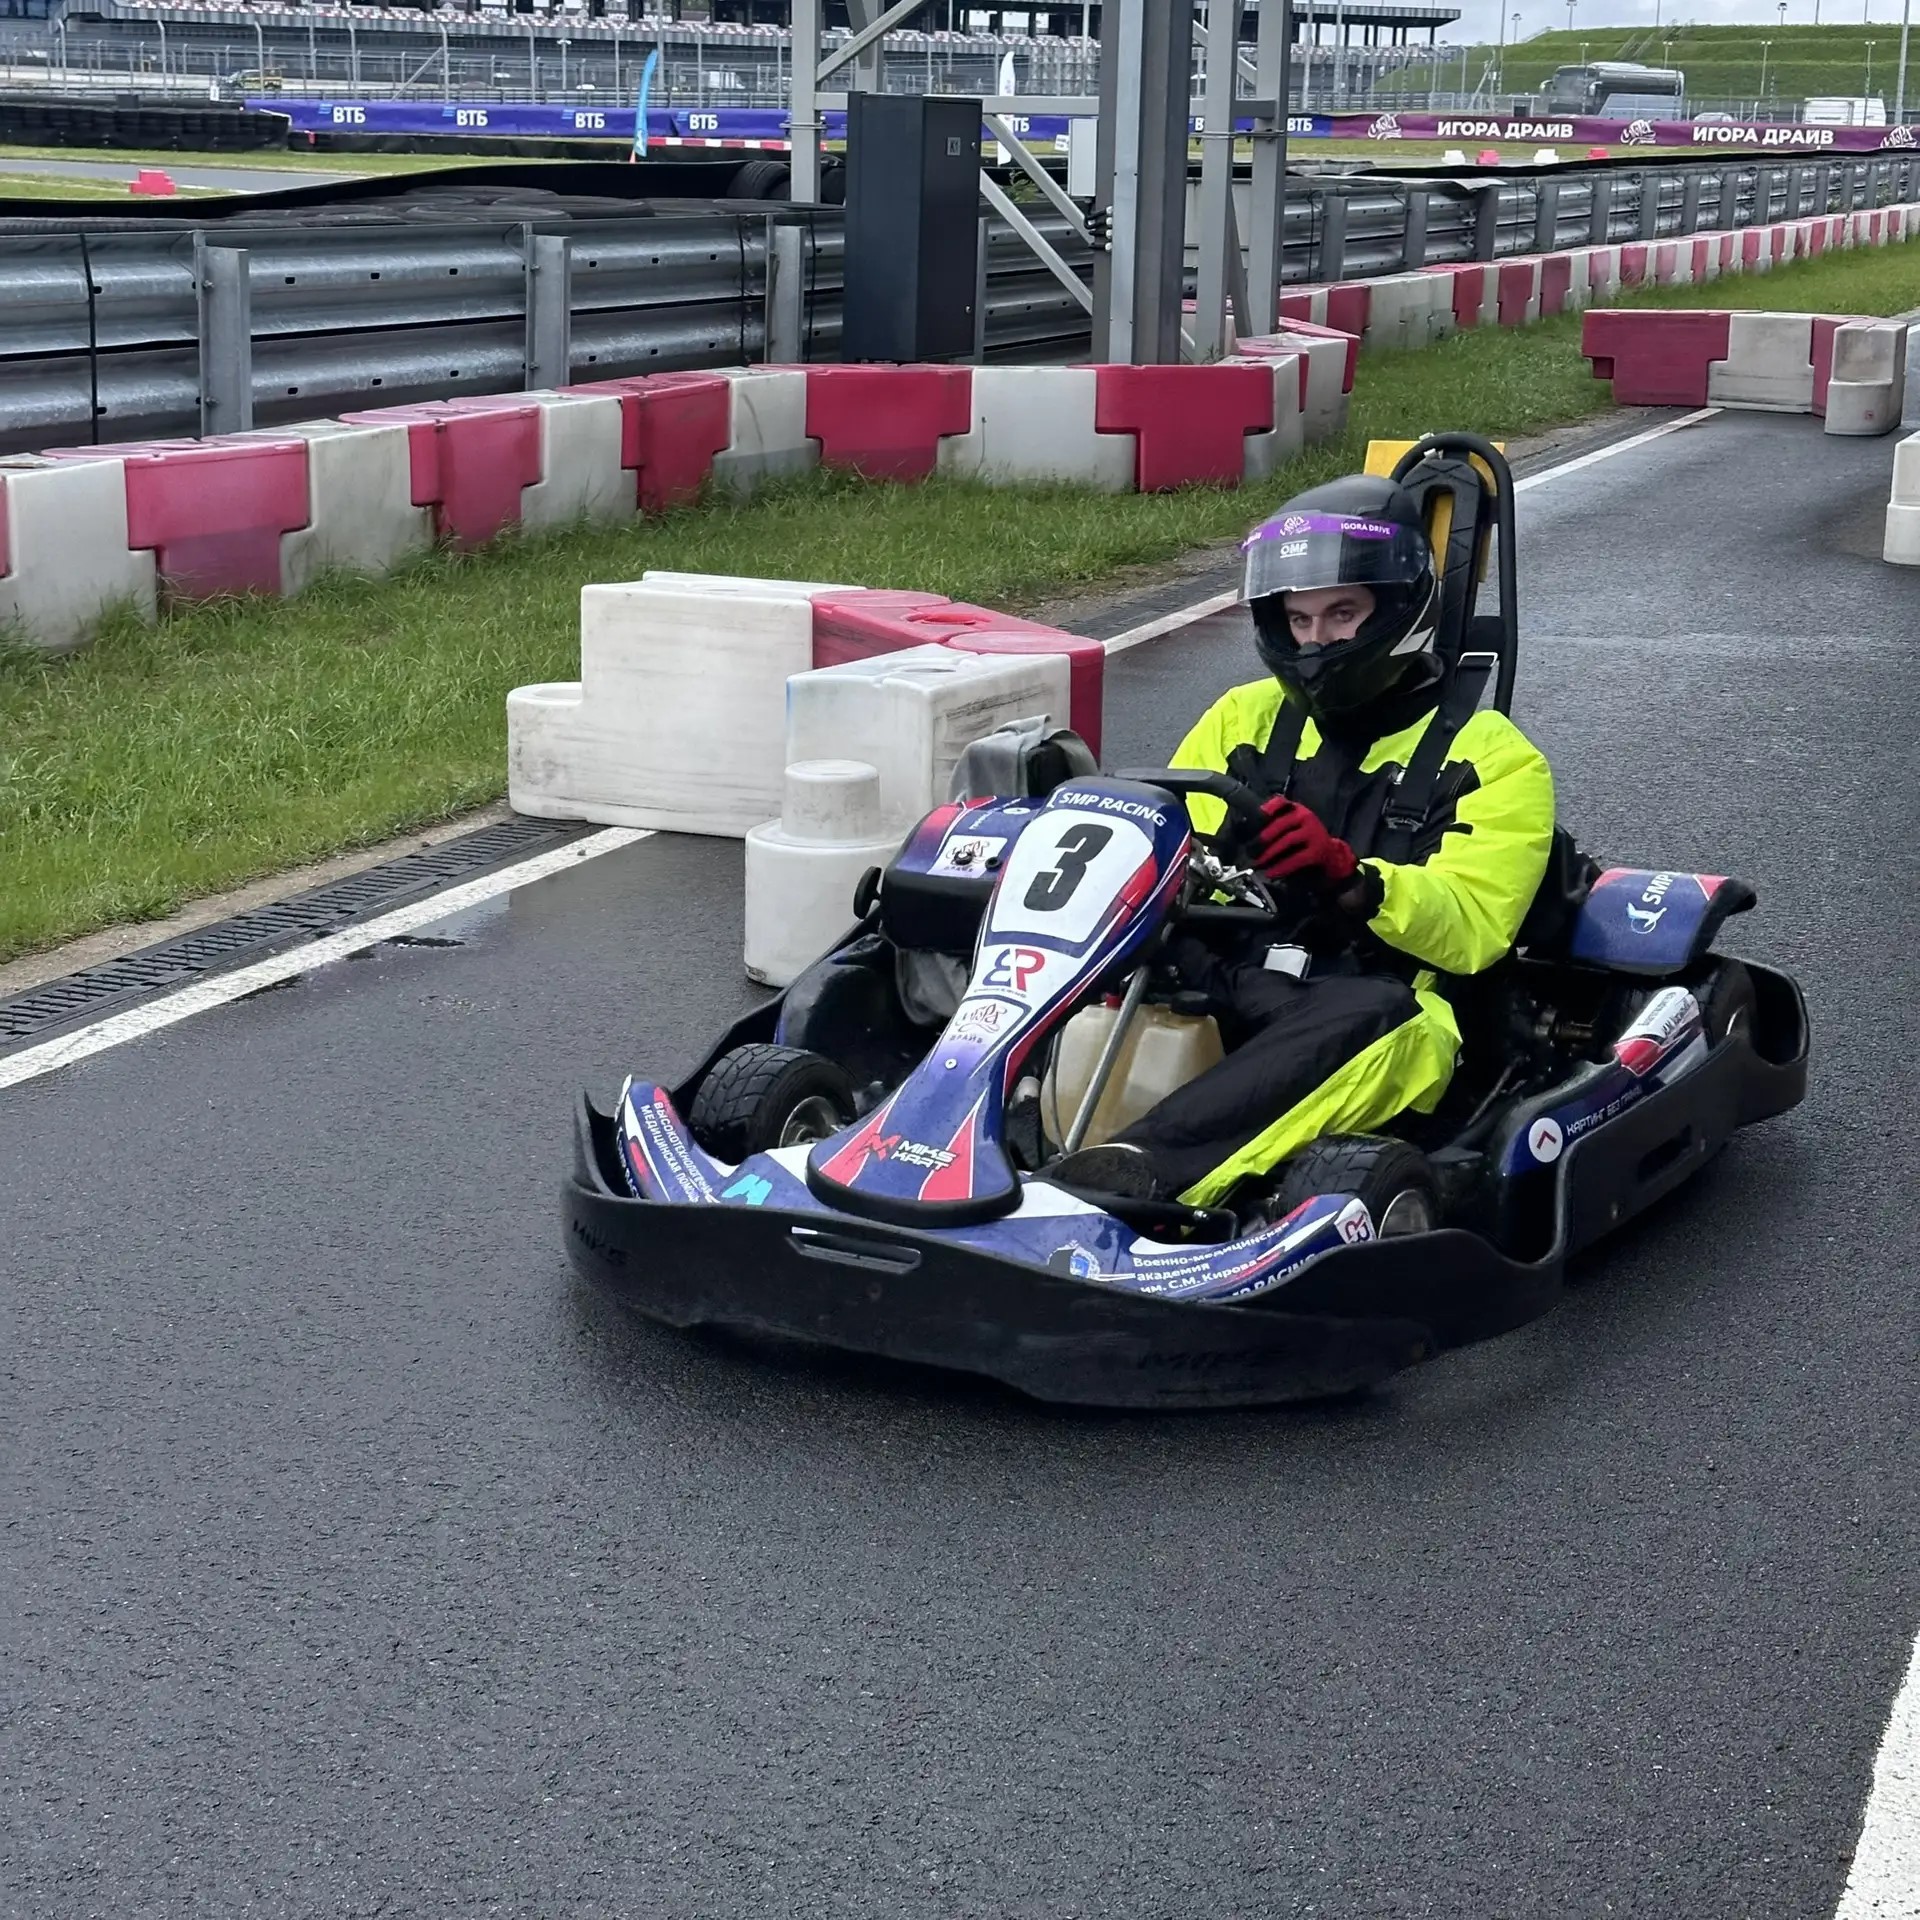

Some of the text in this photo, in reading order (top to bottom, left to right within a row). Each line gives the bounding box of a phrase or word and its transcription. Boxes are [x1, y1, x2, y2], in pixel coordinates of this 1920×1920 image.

[333, 106, 366, 123] ВТБ
[456, 110, 488, 126] ВТБ
[575, 113, 606, 128] ВТБ
[689, 114, 718, 129] ВТБ
[1287, 117, 1313, 131] ВТБ
[1437, 121, 1574, 139] ИГОРА ДРАЙВ
[1693, 126, 1834, 145] ИГОРА ДРАЙВ
[1340, 522, 1391, 535] IGORA DRIVE
[1279, 542, 1308, 556] OMP
[1058, 791, 1168, 828] SMP RACING
[1023, 823, 1114, 912] 3
[640, 1104, 681, 1174] МЕДИЦИНСКАЯ
[898, 1140, 957, 1163] MIKS
[890, 1151, 950, 1171] KART
[1136, 1261, 1211, 1282] академия
[1169, 1275, 1201, 1290] С.М.
[1203, 1258, 1258, 1284] Кирова
